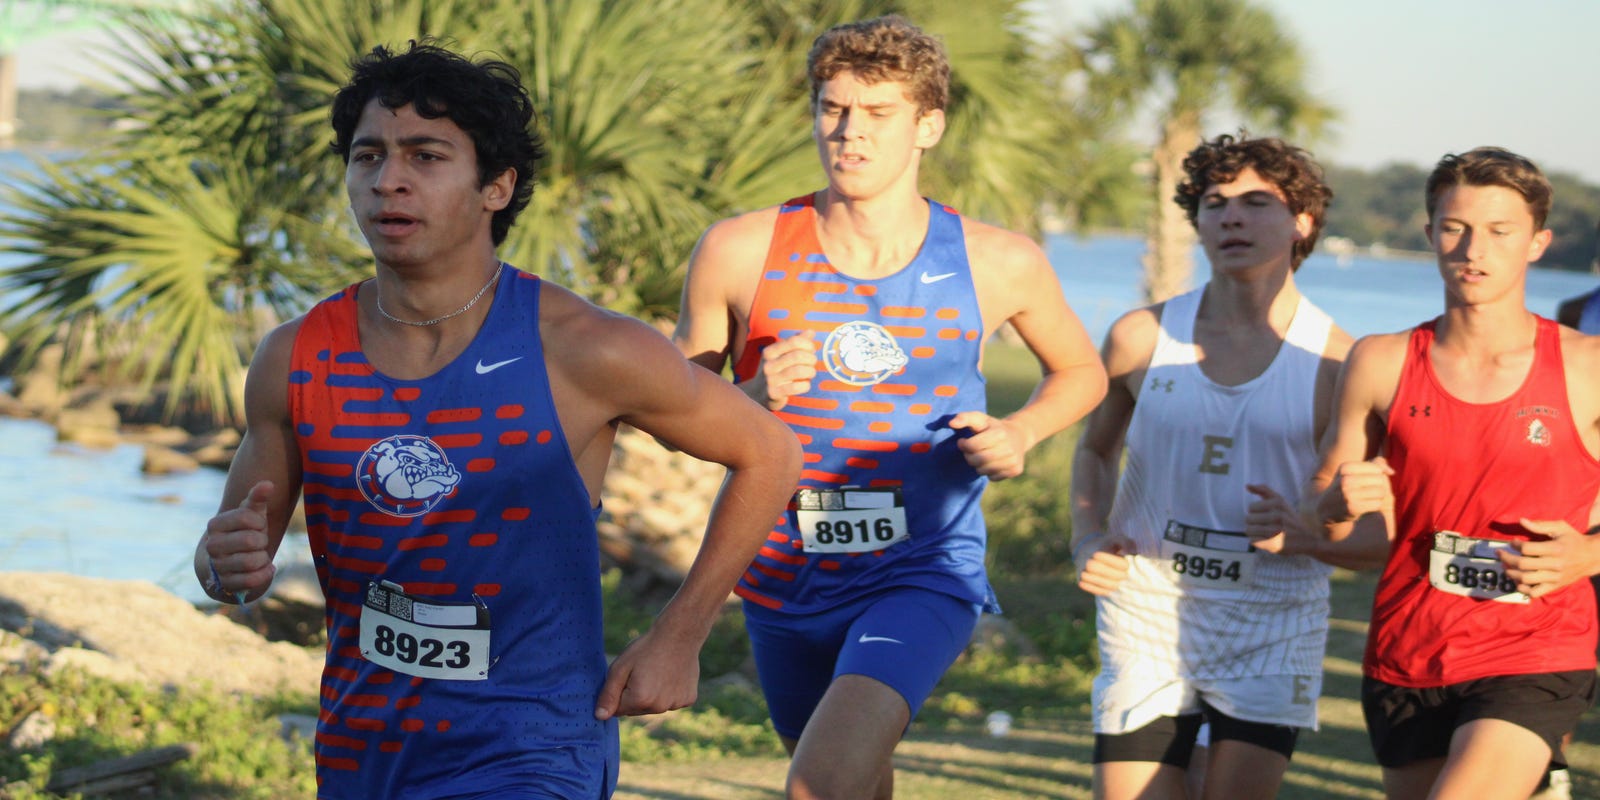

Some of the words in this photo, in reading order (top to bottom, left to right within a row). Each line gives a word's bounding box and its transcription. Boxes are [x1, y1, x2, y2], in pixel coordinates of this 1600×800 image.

[1199, 435, 1233, 475] E
[815, 518, 894, 544] 8916
[1173, 552, 1240, 582] 8954
[1445, 564, 1517, 593] 8898
[374, 625, 470, 669] 8923
[1291, 675, 1312, 704] E
